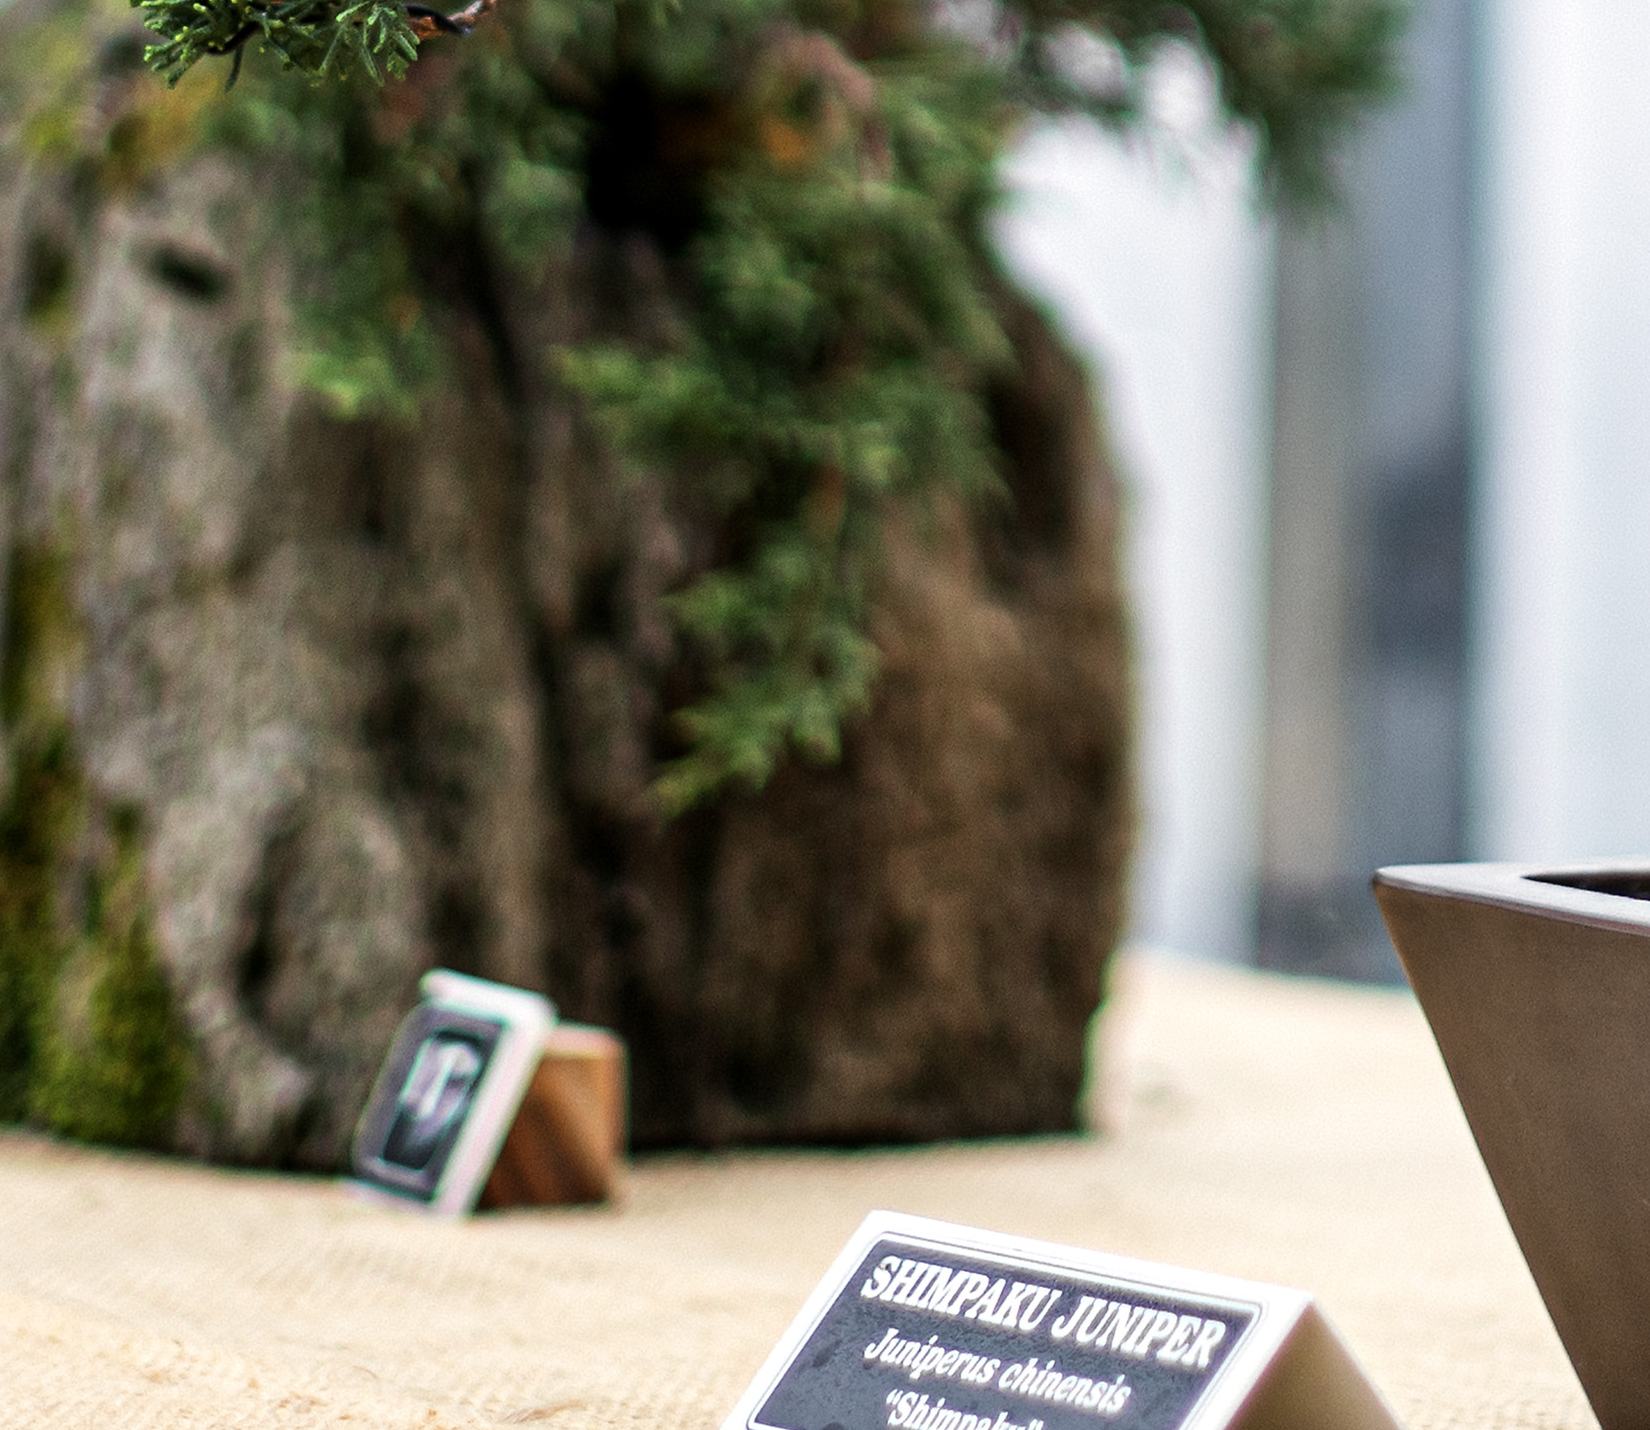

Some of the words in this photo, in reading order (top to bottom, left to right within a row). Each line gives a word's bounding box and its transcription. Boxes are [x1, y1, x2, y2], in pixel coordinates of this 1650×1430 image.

[861, 1255, 1063, 1332] SHIMPAKU
[1052, 1296, 1227, 1367] JUNIPER
[863, 1327, 1001, 1382] Juniperus
[998, 1357, 1131, 1413] chinensis
